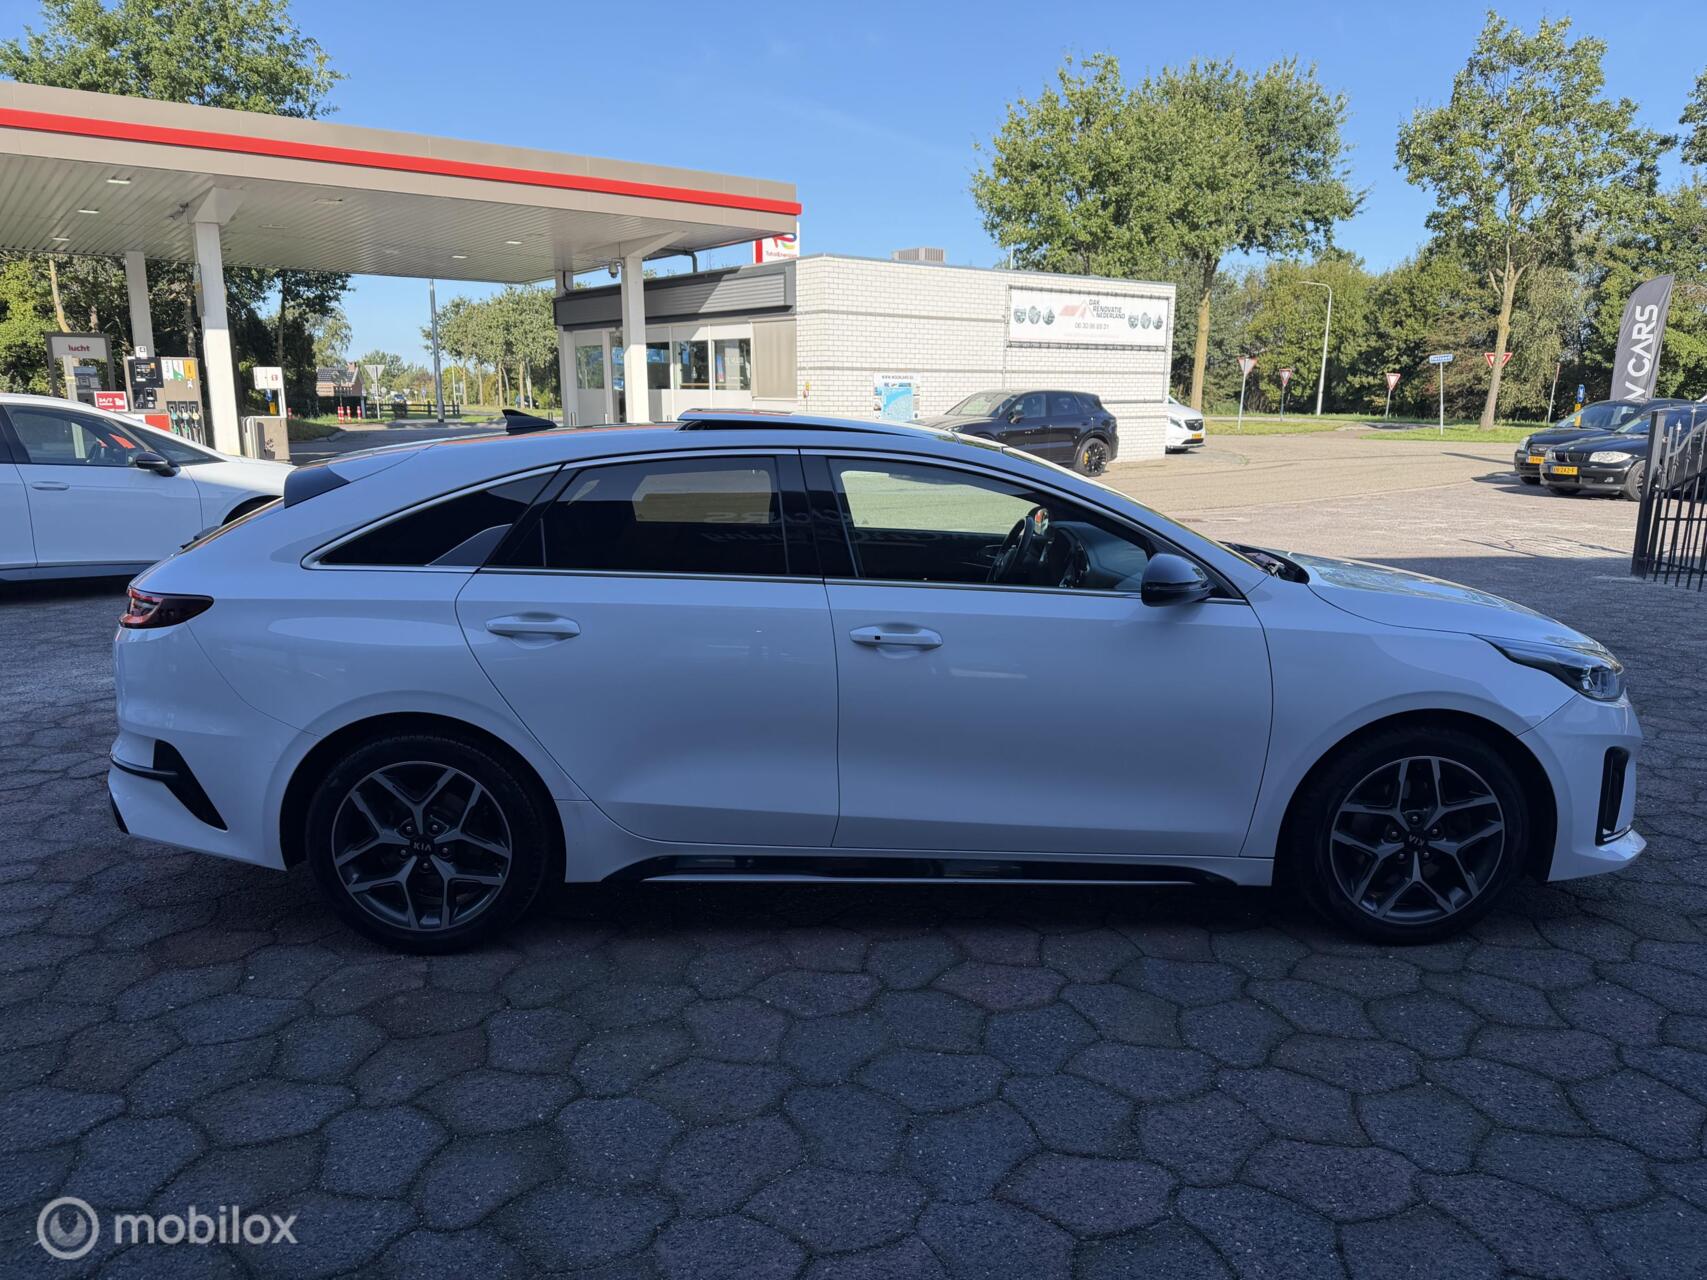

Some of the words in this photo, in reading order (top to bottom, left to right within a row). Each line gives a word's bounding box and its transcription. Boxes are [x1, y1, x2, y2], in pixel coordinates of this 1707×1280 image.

[1088, 298, 1100, 306] DAK
[1092, 305, 1122, 313] RENOVATIE
[1095, 311, 1126, 319] NEDERLAND
[1627, 304, 1658, 377] CARS
[68, 344, 90, 352] lucht
[413, 842, 432, 852] KIA
